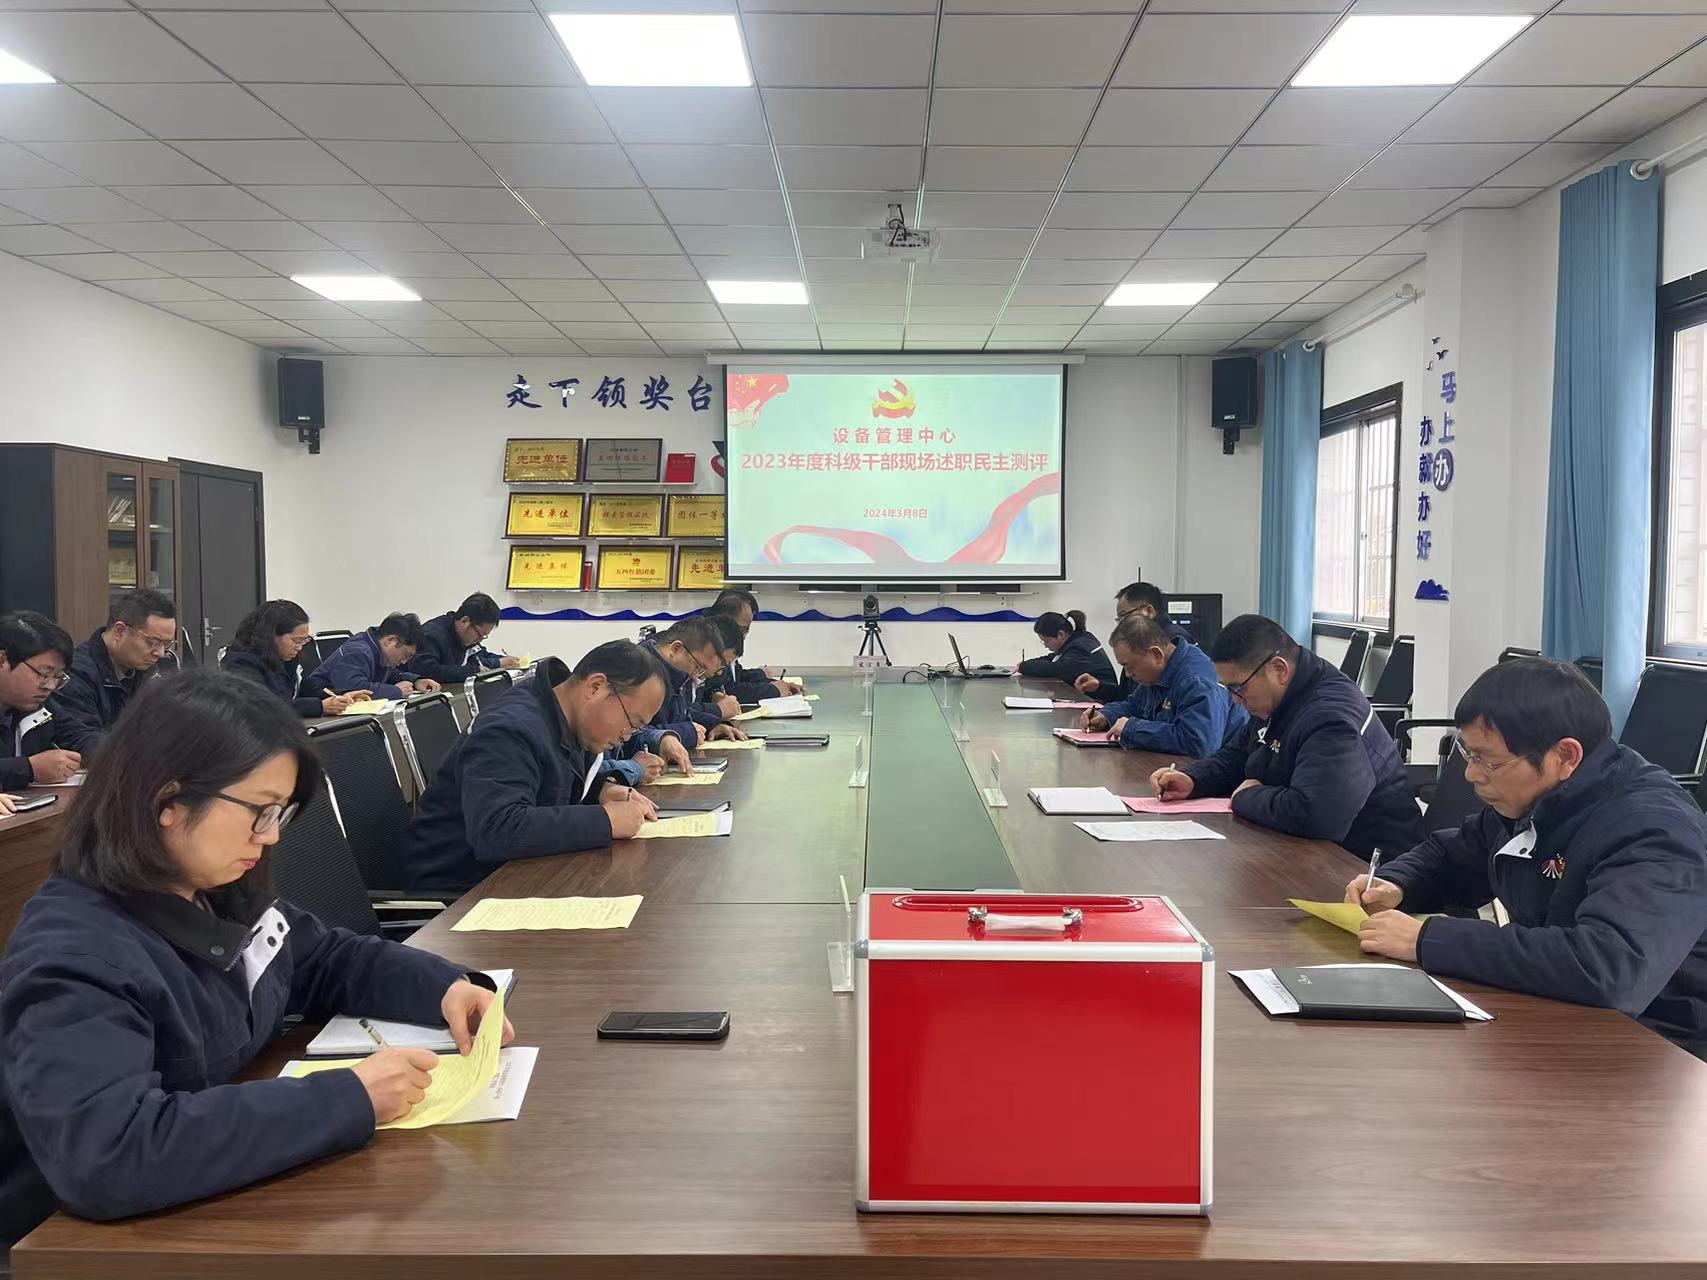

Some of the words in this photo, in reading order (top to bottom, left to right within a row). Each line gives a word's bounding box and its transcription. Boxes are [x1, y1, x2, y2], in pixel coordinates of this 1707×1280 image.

[506, 374, 713, 411] 走下领奖台
[832, 427, 957, 444] 设备管理中心
[1434, 371, 1457, 487] 马上办
[516, 454, 568, 465] 先进单位
[741, 452, 1048, 472] 2023年度科级干部现场述职民主测评
[1416, 416, 1434, 560] 办就办好
[522, 508, 571, 519] 先进单位
[677, 509, 724, 520] 团体一等
[863, 508, 928, 519] 2024年3月8日
